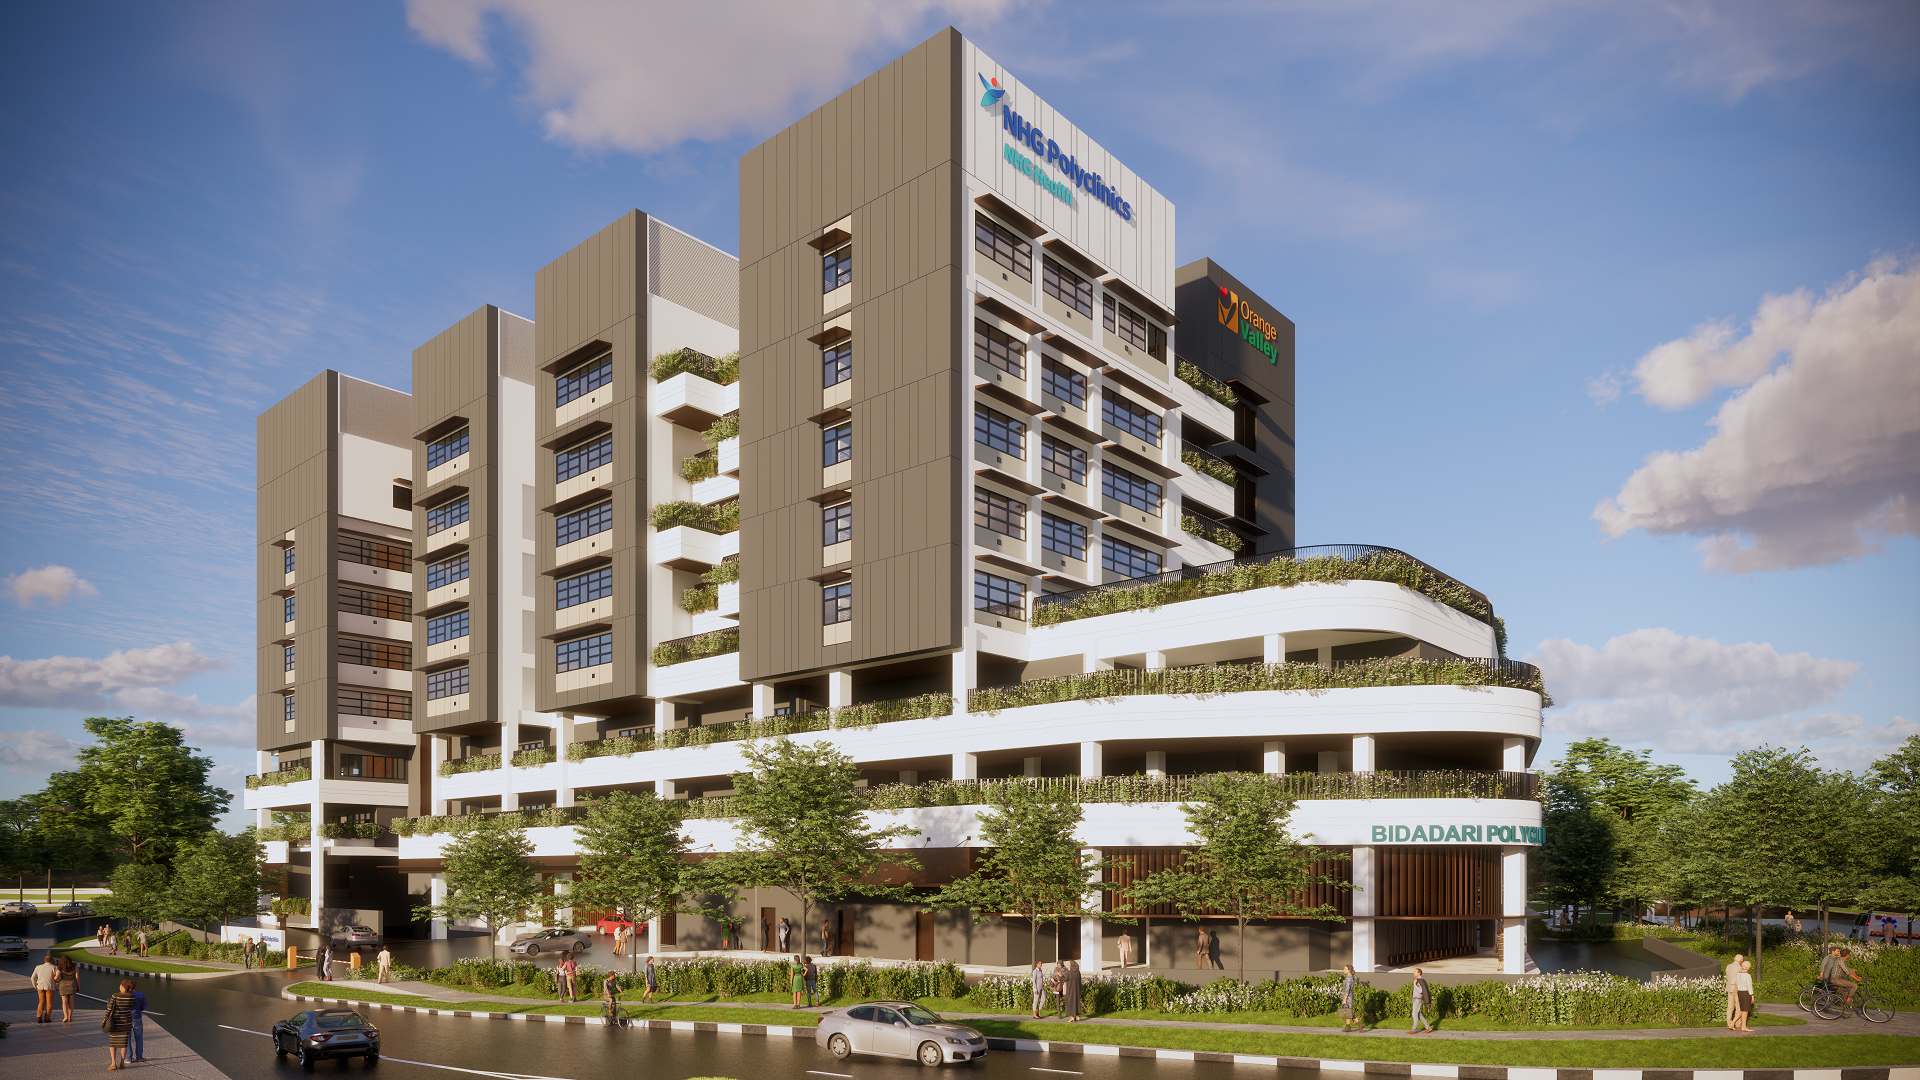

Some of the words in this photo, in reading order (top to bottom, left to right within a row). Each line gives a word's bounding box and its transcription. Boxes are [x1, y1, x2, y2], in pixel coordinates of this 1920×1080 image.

[1003, 104, 1045, 157] NHG
[1047, 138, 1132, 221] Polyclinics
[1003, 142, 1032, 177] NHG
[1034, 164, 1073, 206] Health
[1239, 318, 1278, 364] Valley
[1240, 300, 1277, 341] Orange
[1371, 825, 1482, 843] BIDADARI
